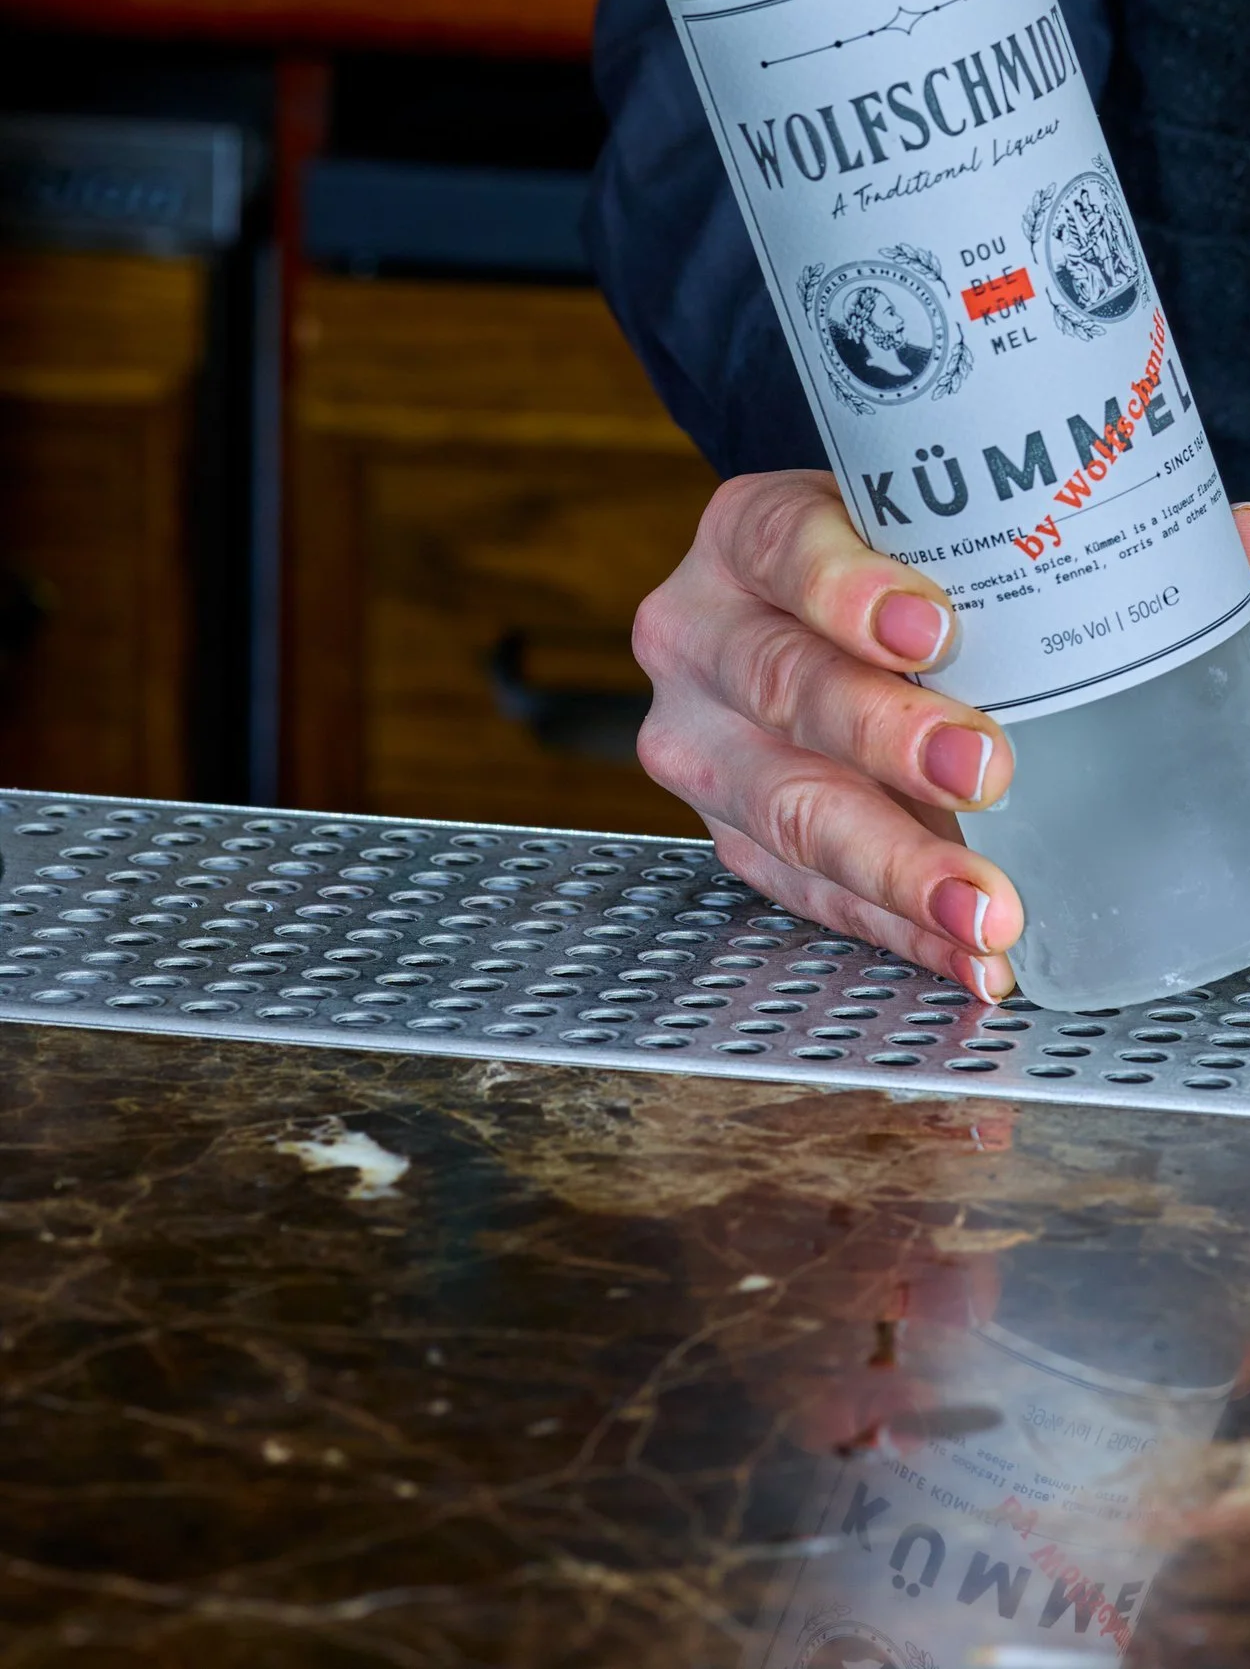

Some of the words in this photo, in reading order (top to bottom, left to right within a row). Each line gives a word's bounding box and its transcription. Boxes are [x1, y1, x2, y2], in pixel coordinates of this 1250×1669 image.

[737, 4, 1077, 190] WOLFSCHMIDT
[832, 192, 848, 219] A
[853, 146, 983, 212] Traditional
[992, 118, 1060, 166] Liqueur
[960, 235, 1006, 267] DOU
[970, 265, 1017, 296] BLE
[981, 294, 1028, 326] KÜM
[990, 326, 1037, 355] MEL
[862, 358, 1192, 527] KÜMMEL
[1013, 514, 1062, 561] by
[1053, 306, 1165, 510] Wolfschmidt
[951, 526, 1028, 557] KÜMMEL
[1163, 444, 1195, 474] SINCE
[970, 567, 1028, 592] cocktail
[1035, 553, 1078, 574] spice,
[1133, 521, 1146, 534] is
[1151, 517, 1158, 526] a
[1161, 492, 1195, 519] liqueur
[996, 583, 1042, 603] seeds,
[1055, 560, 1107, 585] fennel,
[1118, 537, 1153, 560] orris
[1161, 521, 1180, 539] and
[1186, 503, 1207, 525] other
[1040, 628, 1083, 655] 39%
[1082, 616, 1111, 640] Vol
